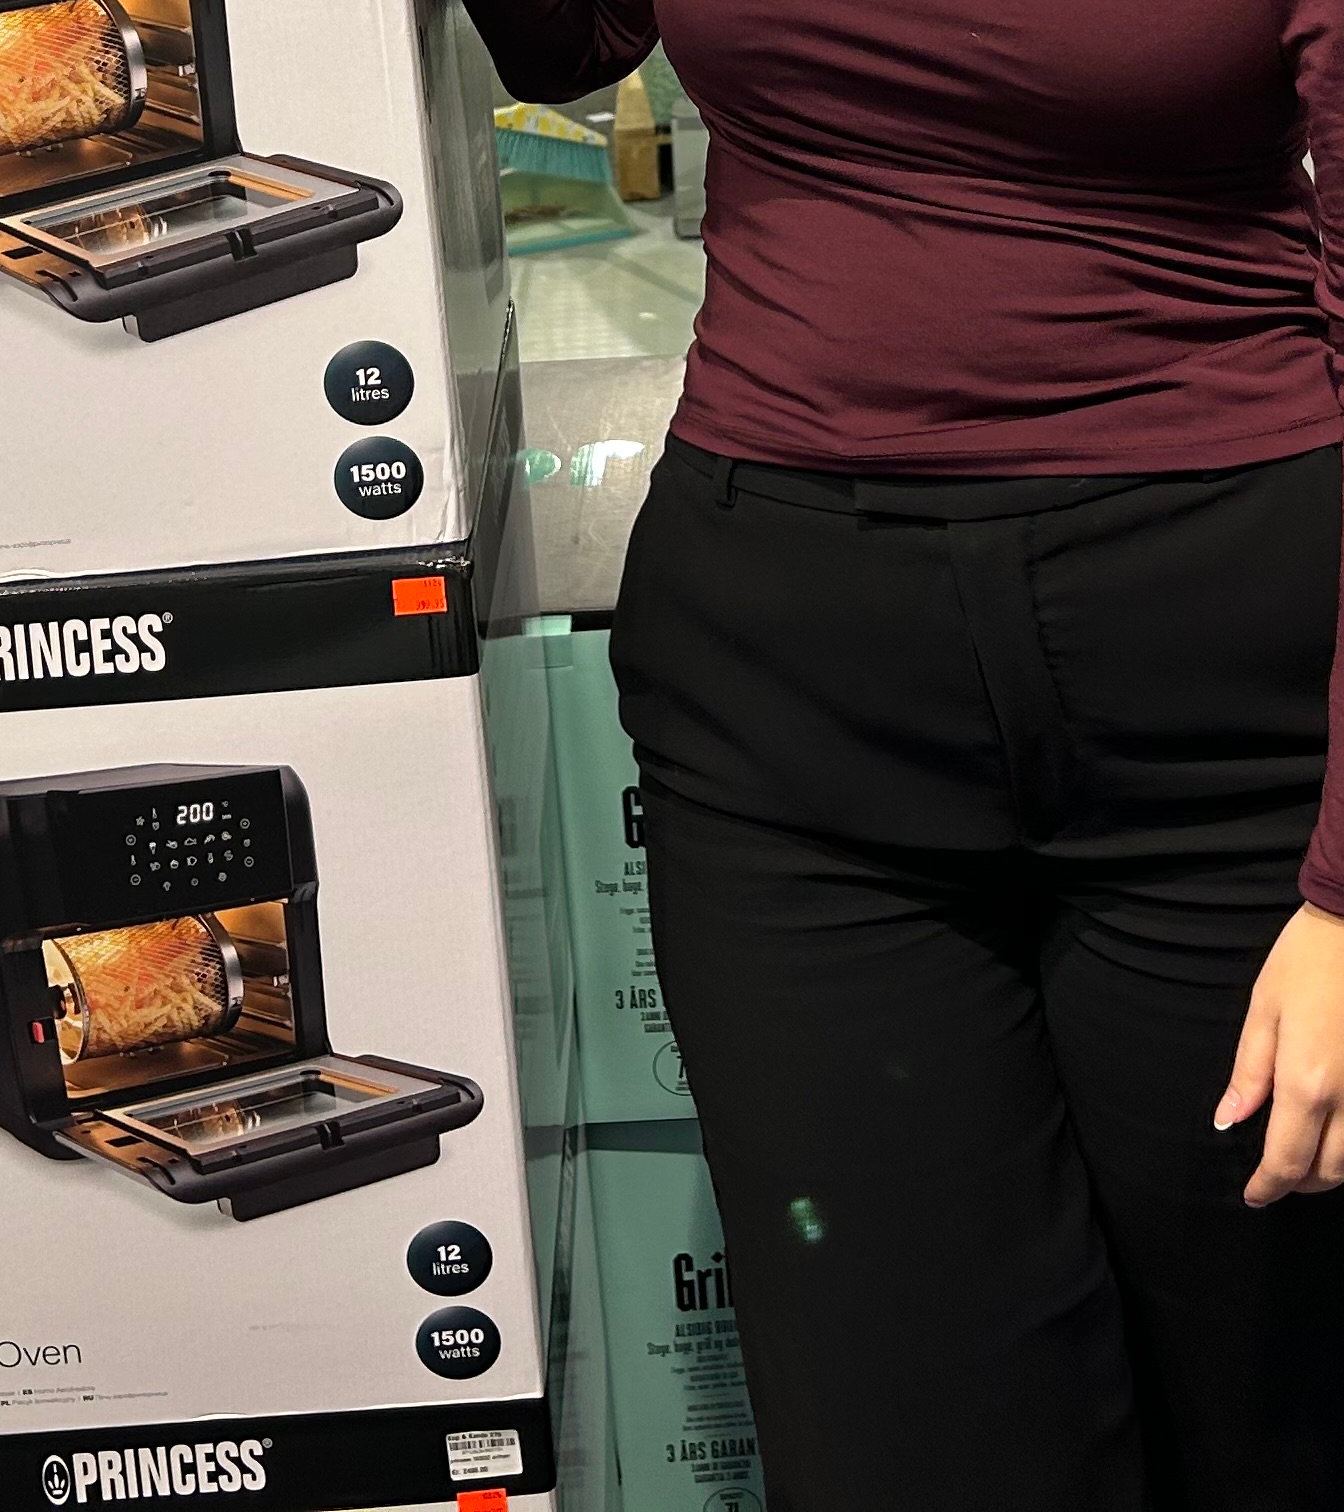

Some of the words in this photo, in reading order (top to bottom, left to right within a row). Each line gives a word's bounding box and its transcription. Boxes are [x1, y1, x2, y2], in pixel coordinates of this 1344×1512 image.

[355, 367, 382, 386] 12
[351, 386, 390, 402] litres
[349, 461, 407, 482] 1500
[358, 481, 402, 497] watts
[177, 802, 214, 825] 200
[615, 990, 624, 1010] 3
[629, 985, 657, 1009] ÅRS
[437, 1244, 461, 1261] 12
[432, 1262, 469, 1276] litres
[431, 1328, 484, 1346] 1500
[439, 1345, 480, 1359] watts
[666, 1444, 675, 1463] 3
[680, 1440, 706, 1462] ÅRS
[72, 1440, 267, 1503] PRINCESS
